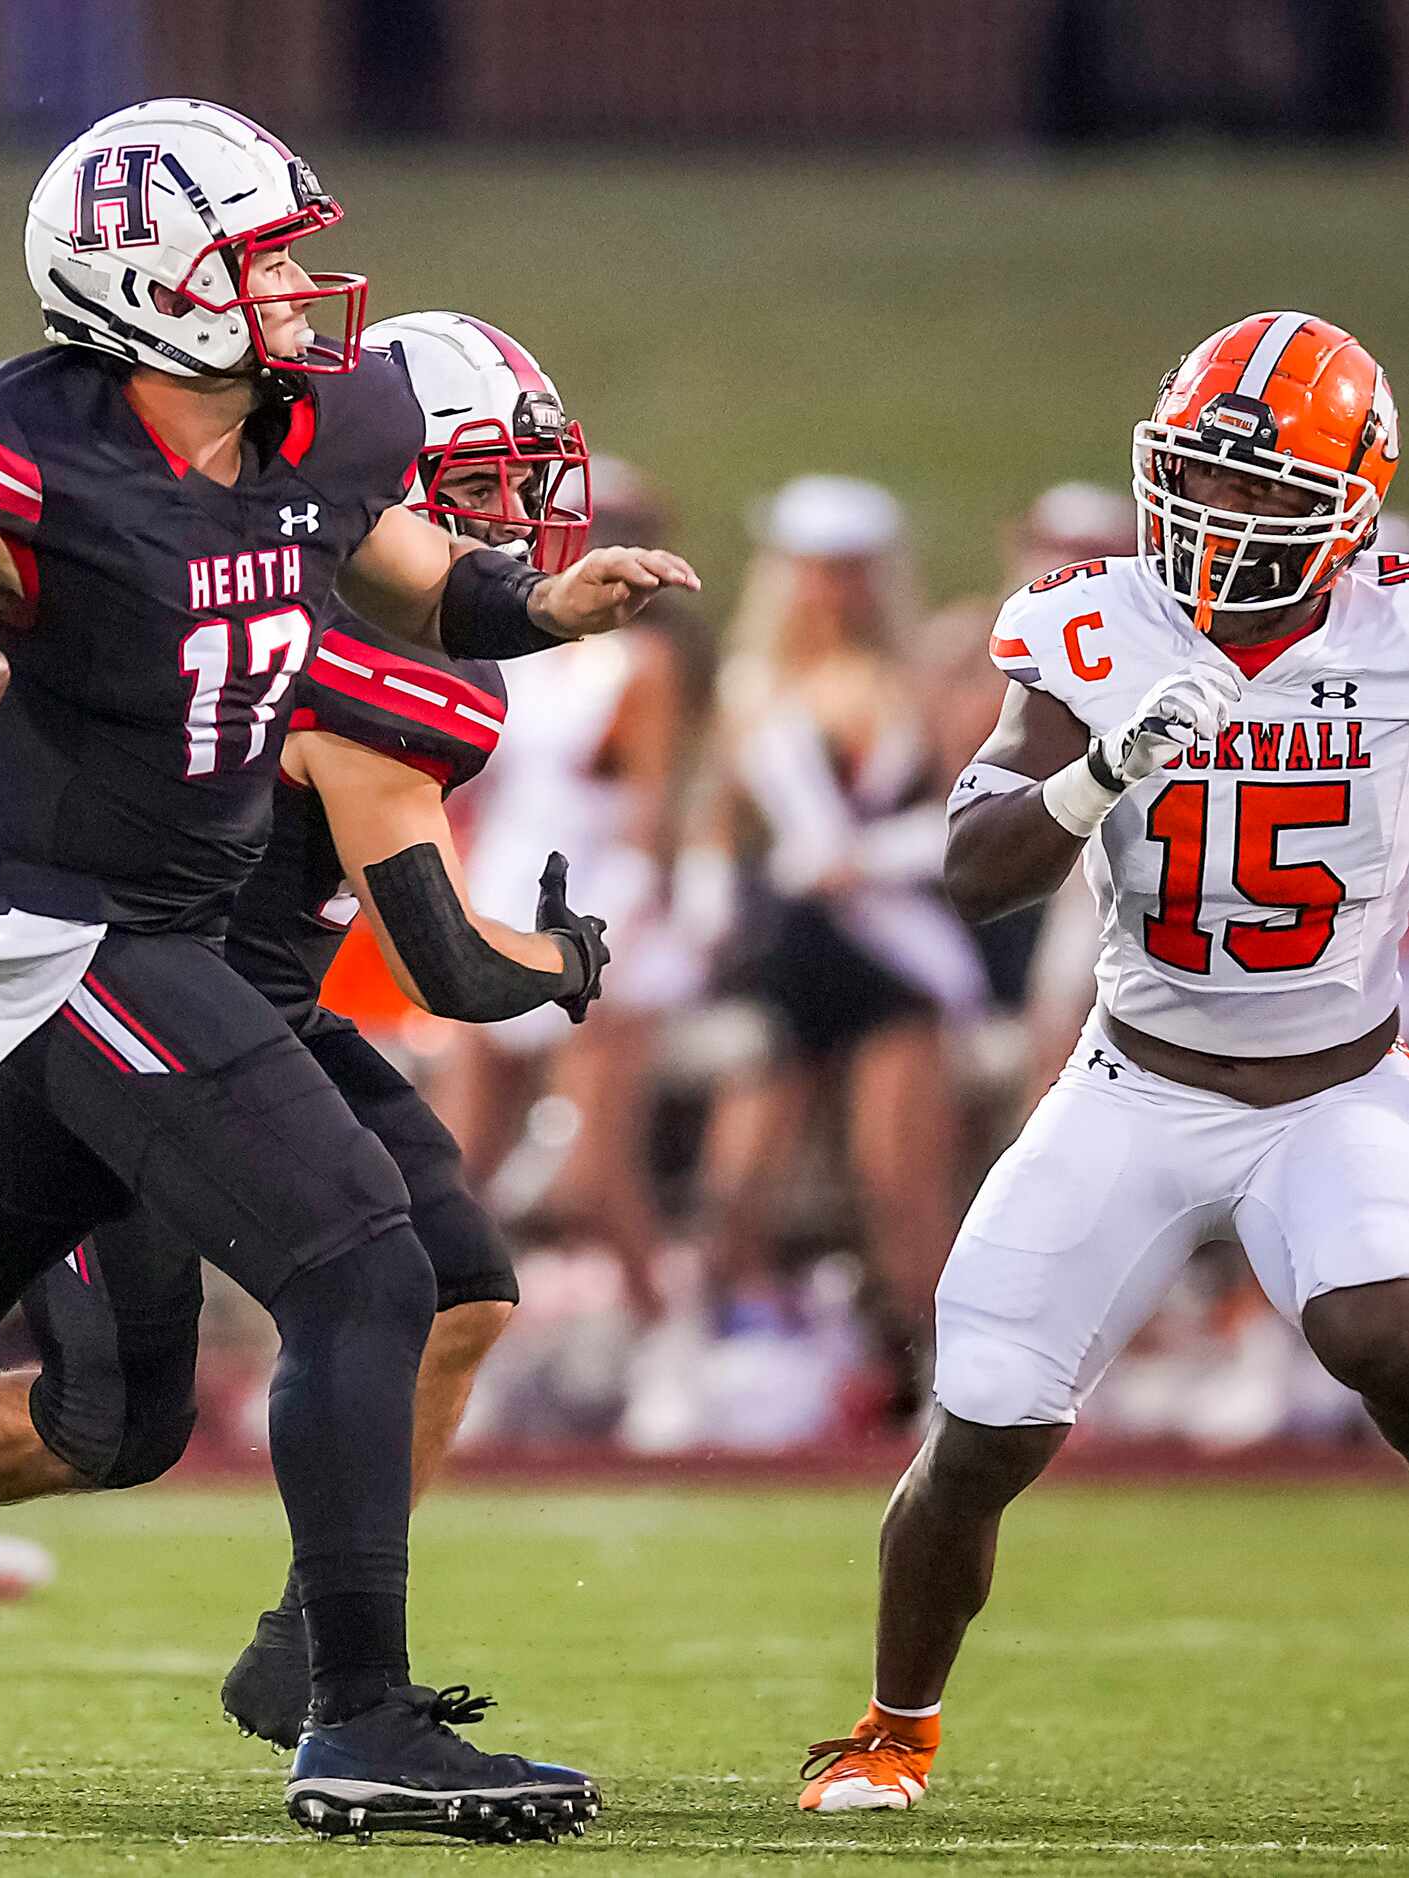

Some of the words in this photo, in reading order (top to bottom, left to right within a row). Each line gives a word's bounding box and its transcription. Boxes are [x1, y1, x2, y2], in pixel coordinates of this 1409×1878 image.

[69, 145, 161, 253] H
[187, 544, 301, 611] HEATH
[179, 603, 312, 779] 17
[1062, 611, 1113, 682] C
[1160, 721, 1371, 770] CKWALL
[1143, 779, 1351, 975] 15
